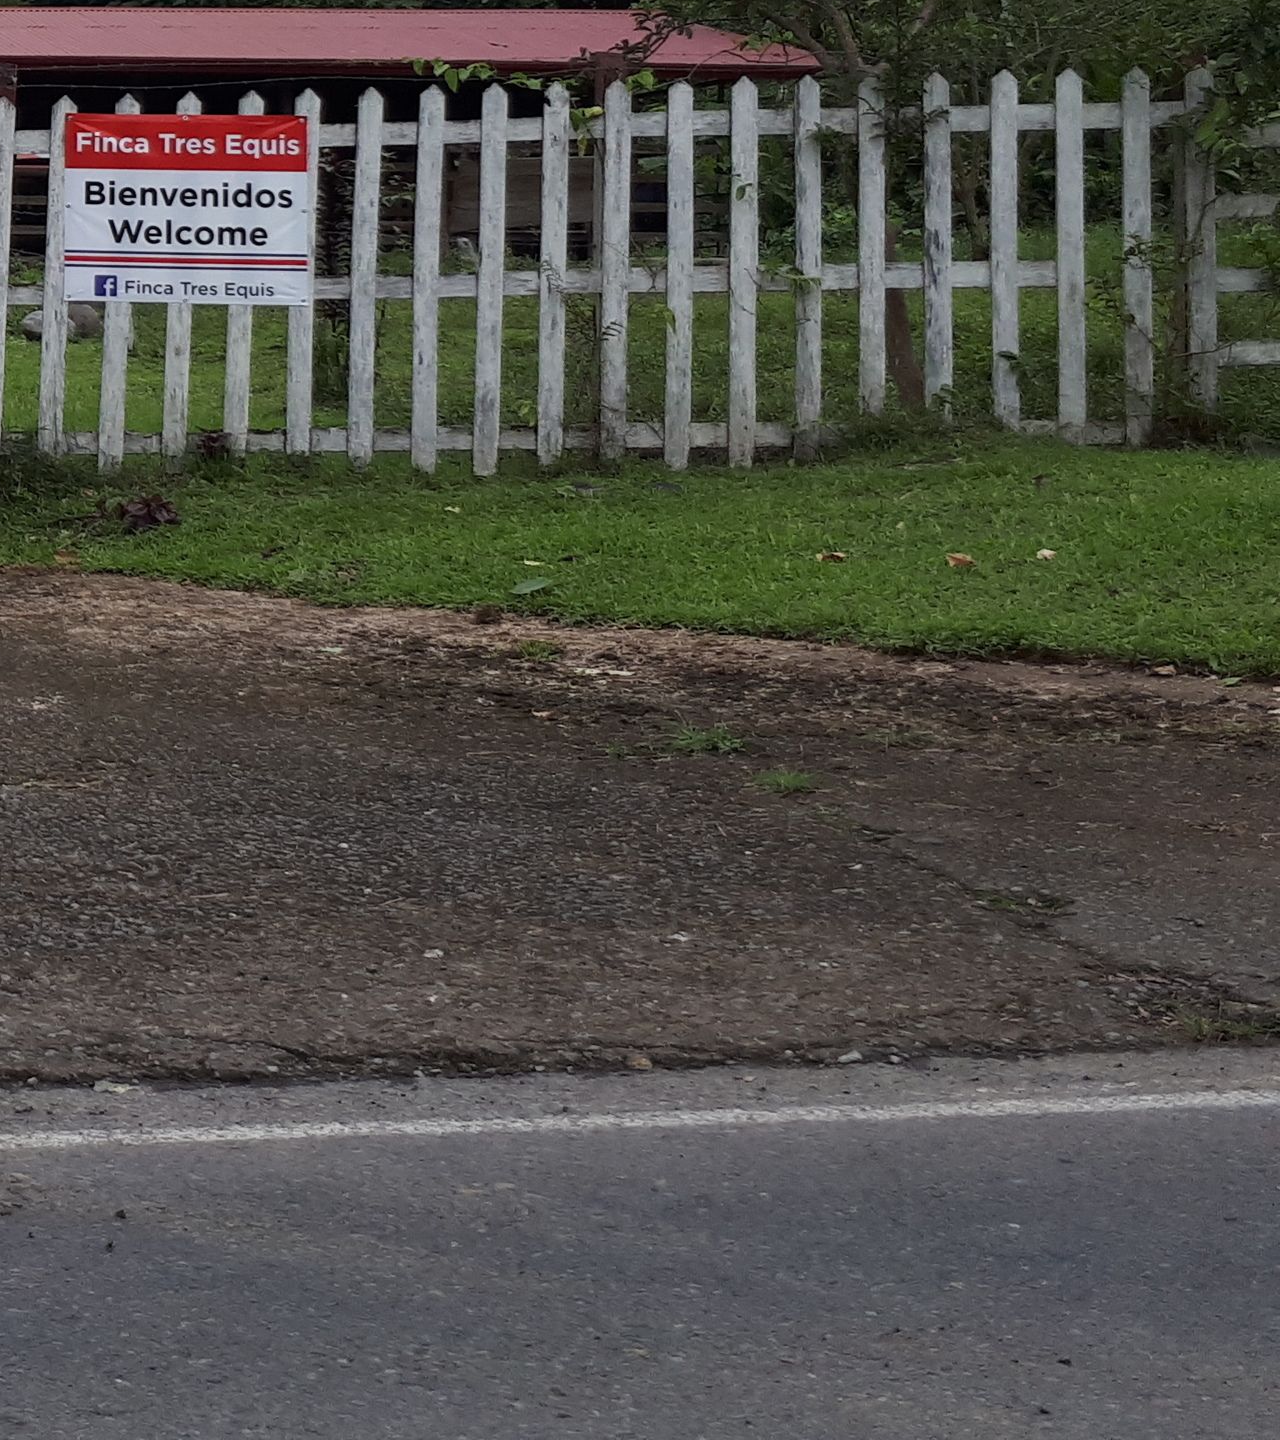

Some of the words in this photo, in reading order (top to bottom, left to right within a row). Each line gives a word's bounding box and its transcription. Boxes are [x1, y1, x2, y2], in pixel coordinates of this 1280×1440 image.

[76, 132, 150, 153] Finca
[158, 133, 216, 155] Tres
[225, 134, 300, 159] Equis
[84, 180, 293, 209] Bienvenidos
[108, 219, 268, 246] Welcome
[124, 280, 174, 295] Finca
[180, 281, 218, 296] Tres
[224, 282, 275, 299] Equis
